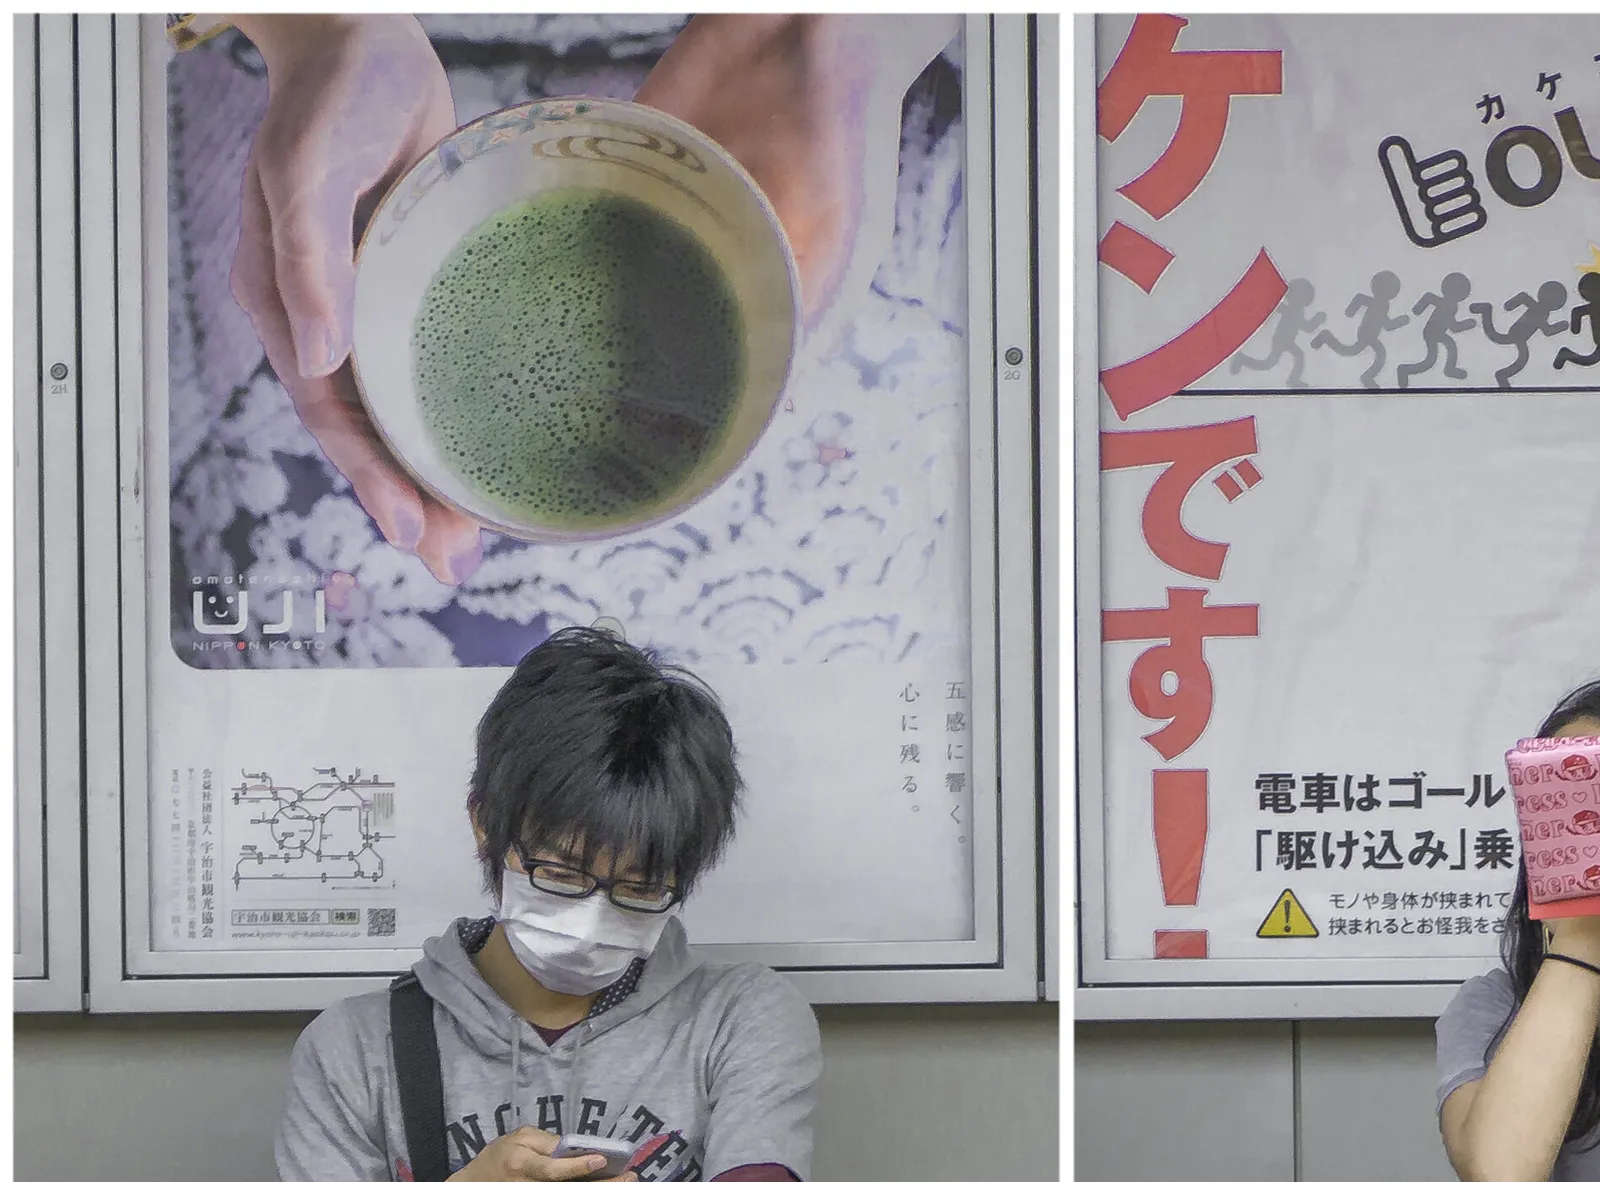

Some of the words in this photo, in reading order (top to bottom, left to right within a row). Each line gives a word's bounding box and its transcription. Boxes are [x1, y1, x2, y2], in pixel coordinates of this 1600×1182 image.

[193, 590, 326, 634] UJI
[268, 640, 326, 651] KYOTO
[899, 682, 921, 813] 心に残る。
[944, 681, 967, 844] 五感に響く。
[1255, 771, 1506, 814] 電車はゴール
[1256, 828, 1516, 872] 「駆け込み」乗
